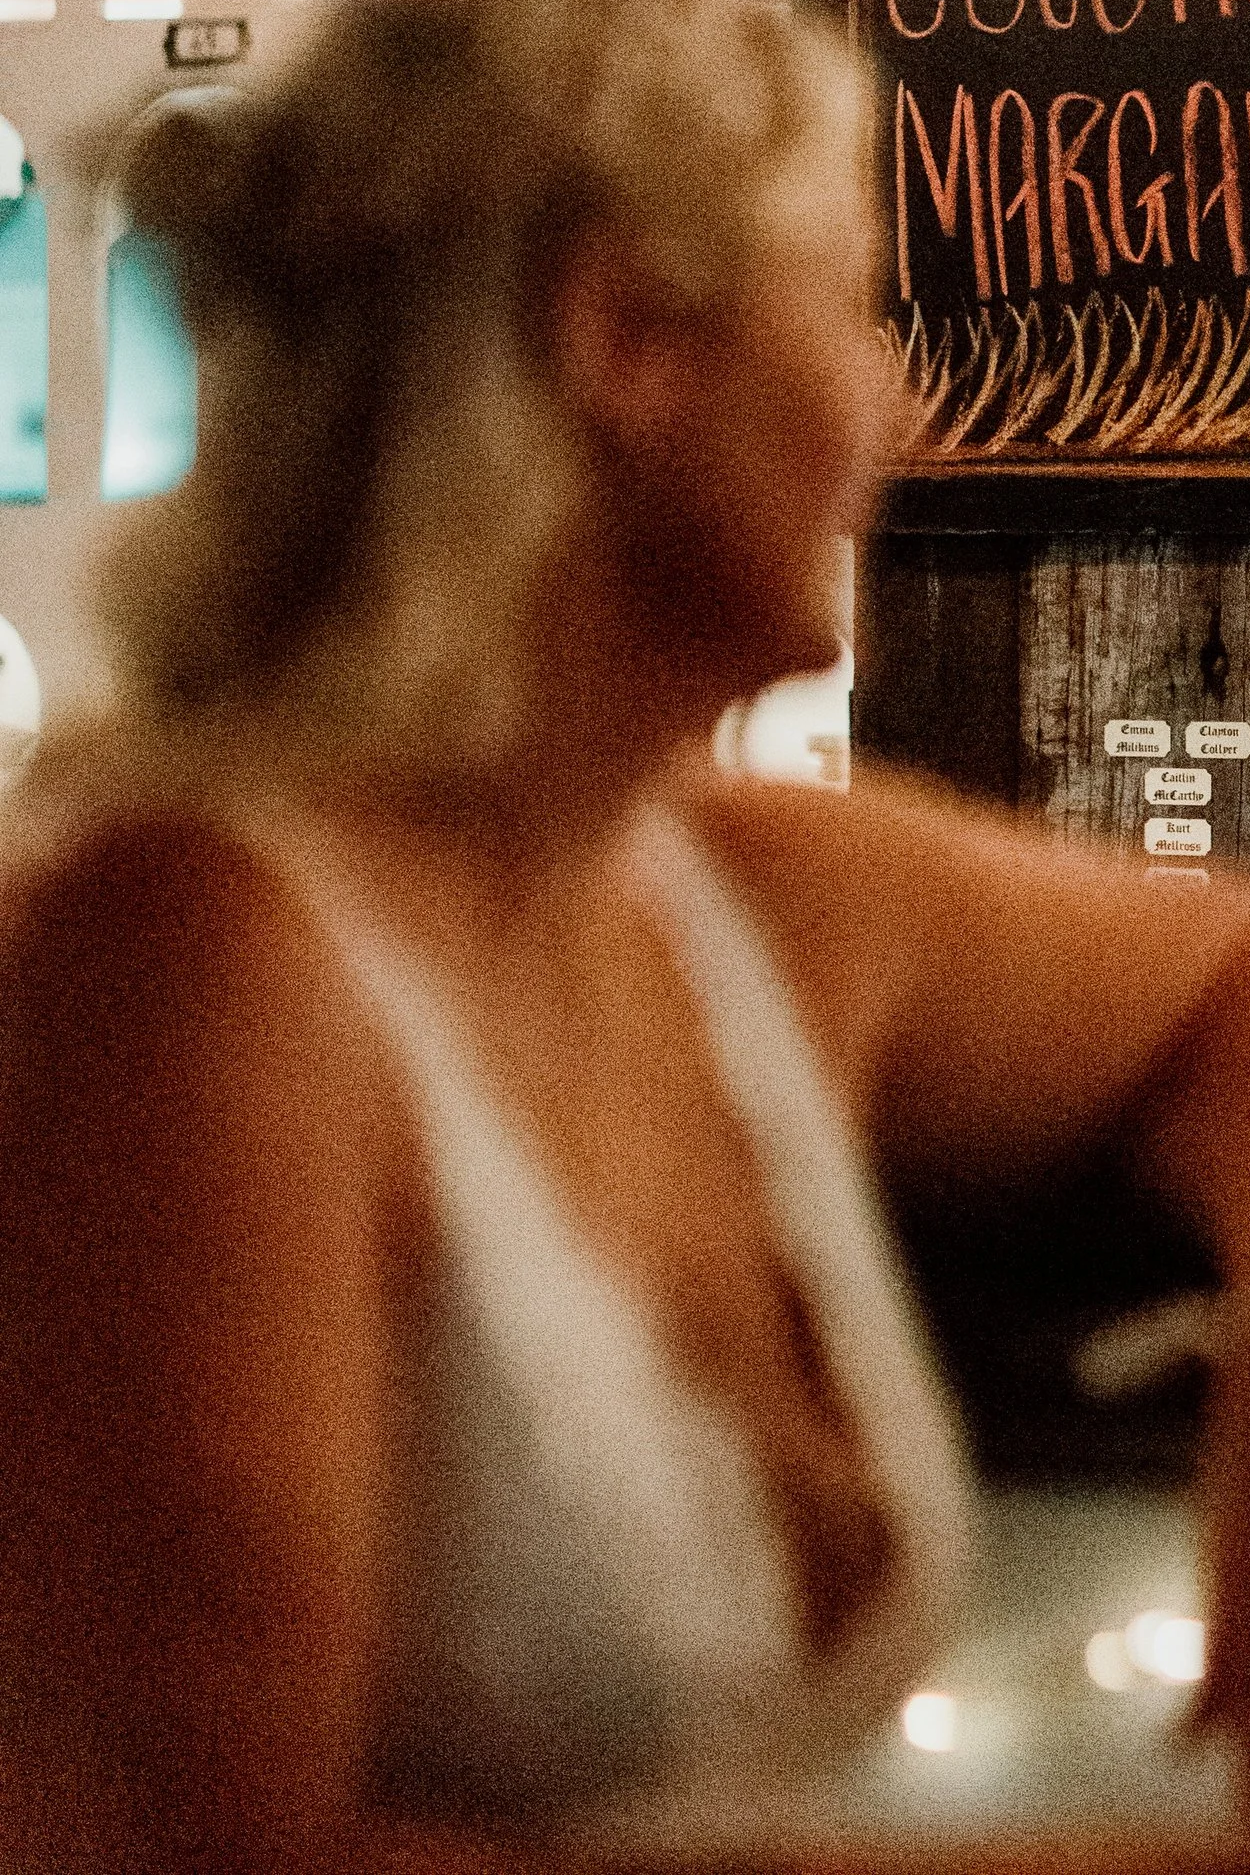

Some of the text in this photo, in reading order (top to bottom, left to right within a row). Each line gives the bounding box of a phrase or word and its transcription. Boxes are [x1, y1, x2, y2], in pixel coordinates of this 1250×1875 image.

[1120, 723, 1155, 735] Emma
[1199, 725, 1239, 738] Clayton
[1200, 743, 1238, 756] Collyer
[1160, 771, 1196, 783] Caitlin
[1153, 789, 1204, 802] McCarthy
[1166, 821, 1191, 834] Kurt
